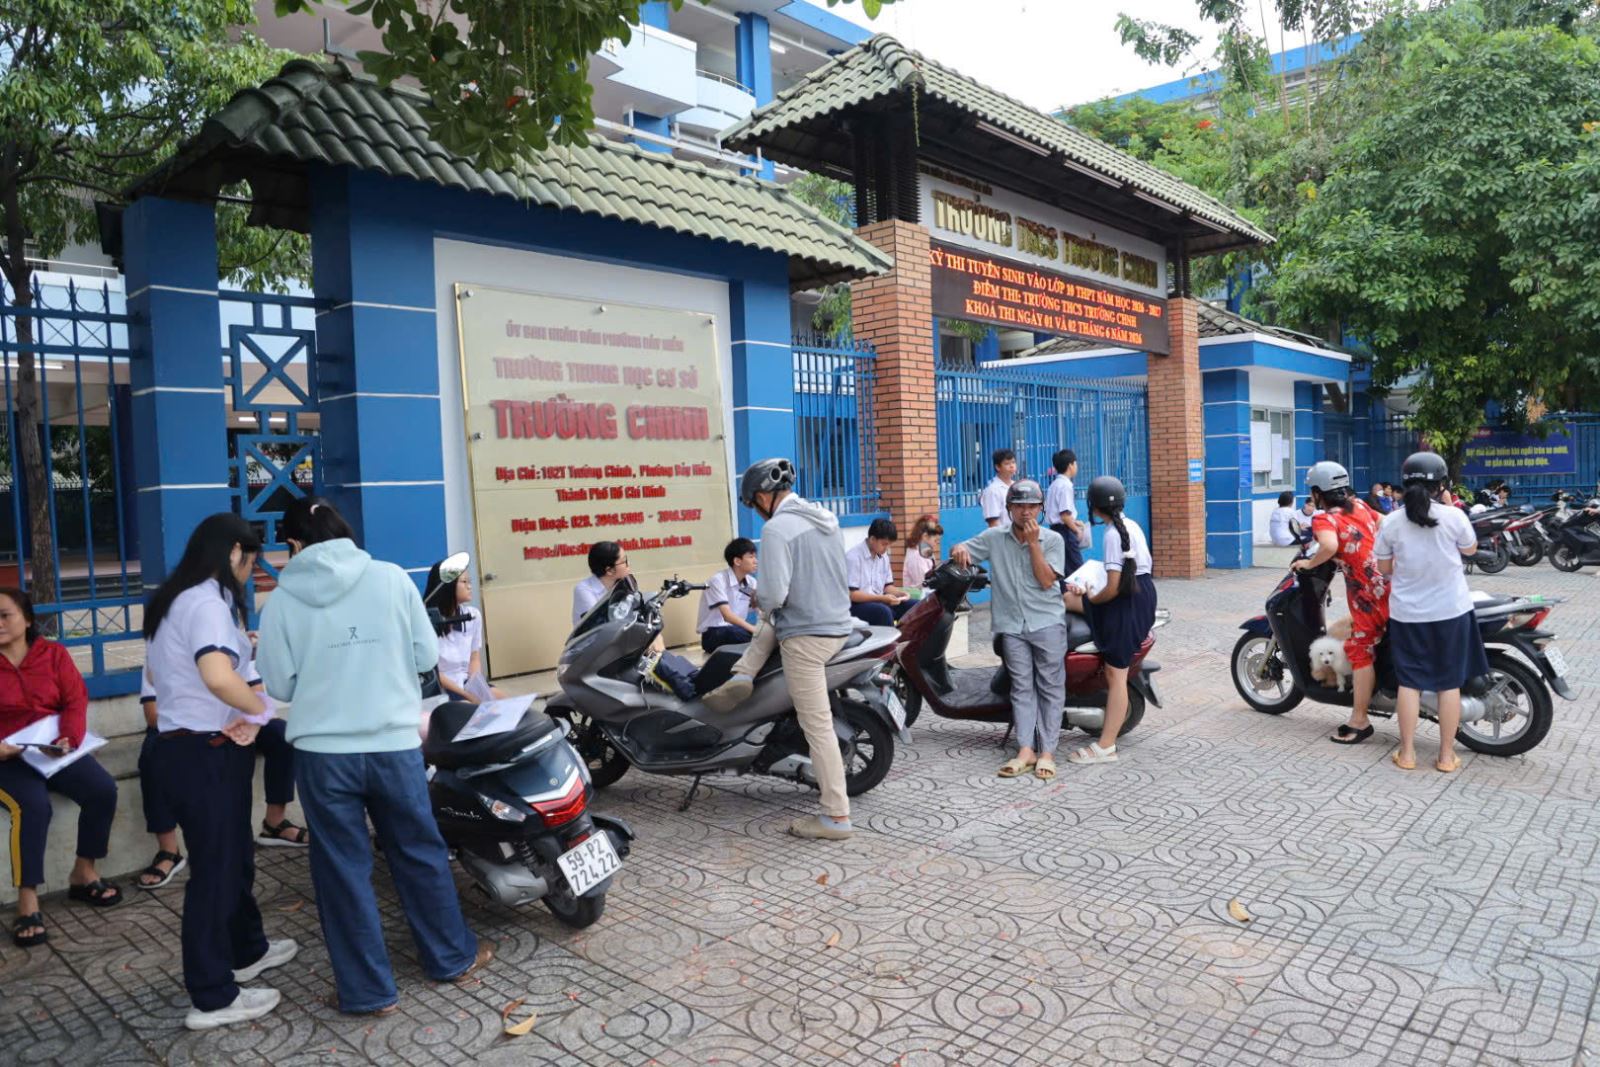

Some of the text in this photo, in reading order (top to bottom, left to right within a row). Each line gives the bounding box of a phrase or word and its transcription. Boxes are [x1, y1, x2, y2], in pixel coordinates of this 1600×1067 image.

[945, 253, 966, 272] THI
[967, 259, 1001, 279] TUYỂN
[1001, 267, 1025, 286] SINH
[1026, 271, 1046, 291] VÀO
[1047, 276, 1065, 294] LỚP
[1075, 285, 1096, 302] THPT
[1096, 289, 1115, 307] NĂM
[1115, 294, 1131, 313] HỌC
[973, 279, 1000, 300] ĐIỂM
[1001, 286, 1022, 303] THI:
[1022, 291, 1061, 312] TRƯỜNG
[1061, 299, 1083, 316] THCS
[1084, 304, 1116, 324] TRƯỜNG
[965, 299, 997, 318] KHOÁ
[998, 305, 1016, 321] THI
[1016, 308, 1043, 327] NGÀY
[1044, 314, 1053, 328] 01
[1055, 314, 1067, 331] VÀ
[1077, 319, 1105, 338] THÁNG
[1105, 326, 1111, 338] 6
[1111, 326, 1128, 341] NĂM
[566, 362, 619, 384] TRUNG
[623, 366, 653, 389] HỌC
[490, 392, 709, 440] TRƯỜNG CHINH
[566, 838, 605, 871] 59-P2
[571, 852, 618, 892] 724.22
